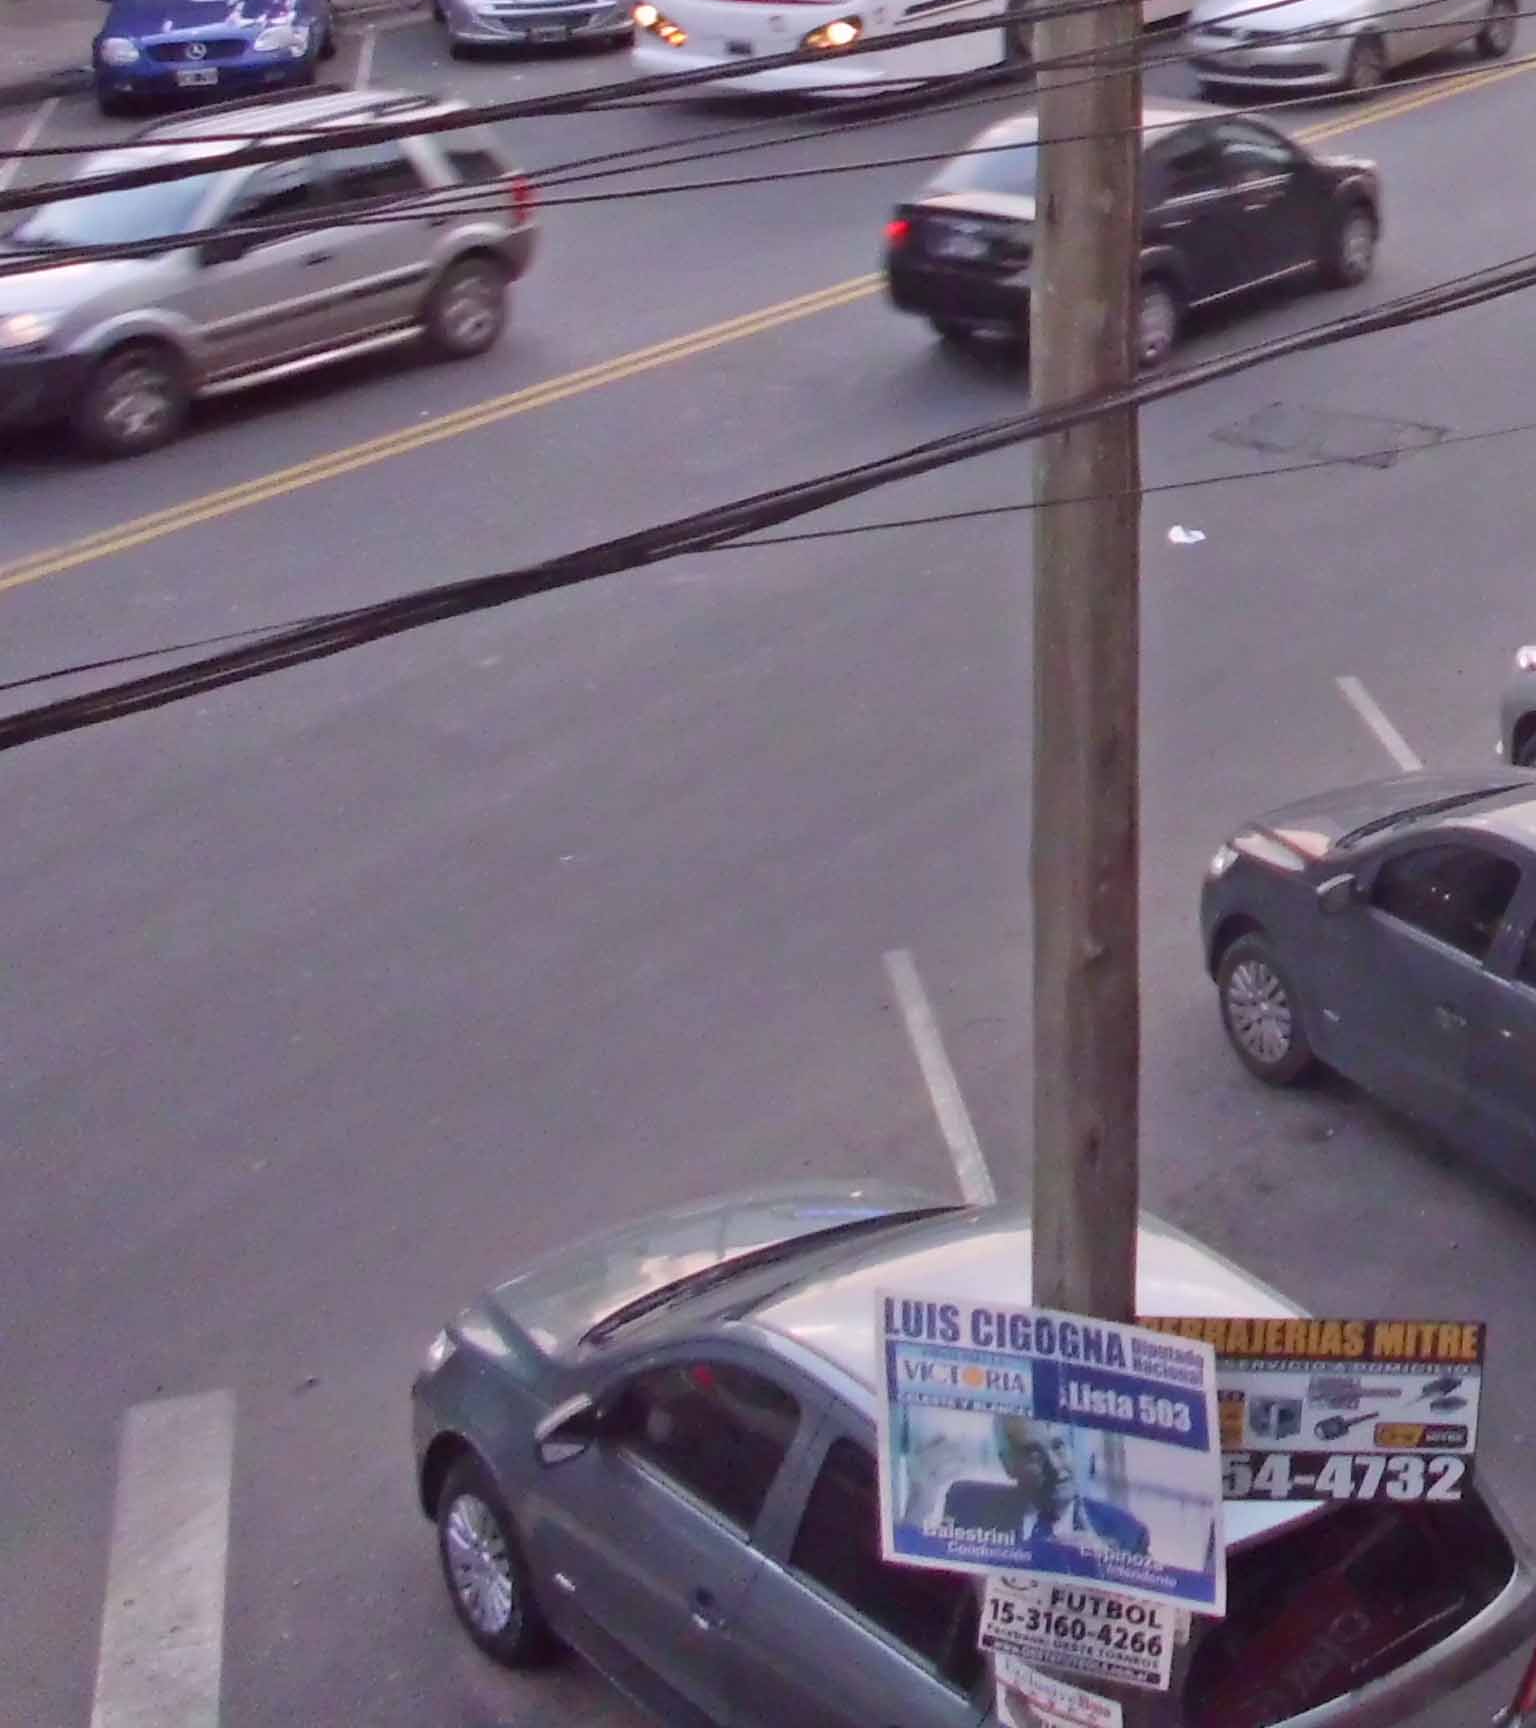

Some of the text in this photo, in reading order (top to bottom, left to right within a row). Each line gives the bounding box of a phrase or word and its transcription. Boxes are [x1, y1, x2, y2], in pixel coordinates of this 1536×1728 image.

[884, 1296, 1127, 1369] LUIS CIGOGNA
[1374, 1322, 1480, 1359] MITRE
[1069, 1380, 1134, 1421] Lista
[1140, 1394, 1192, 1432] 503
[989, 1597, 1164, 1658] 15-3160-4266
[1051, 1588, 1164, 1630] FUTBOL
